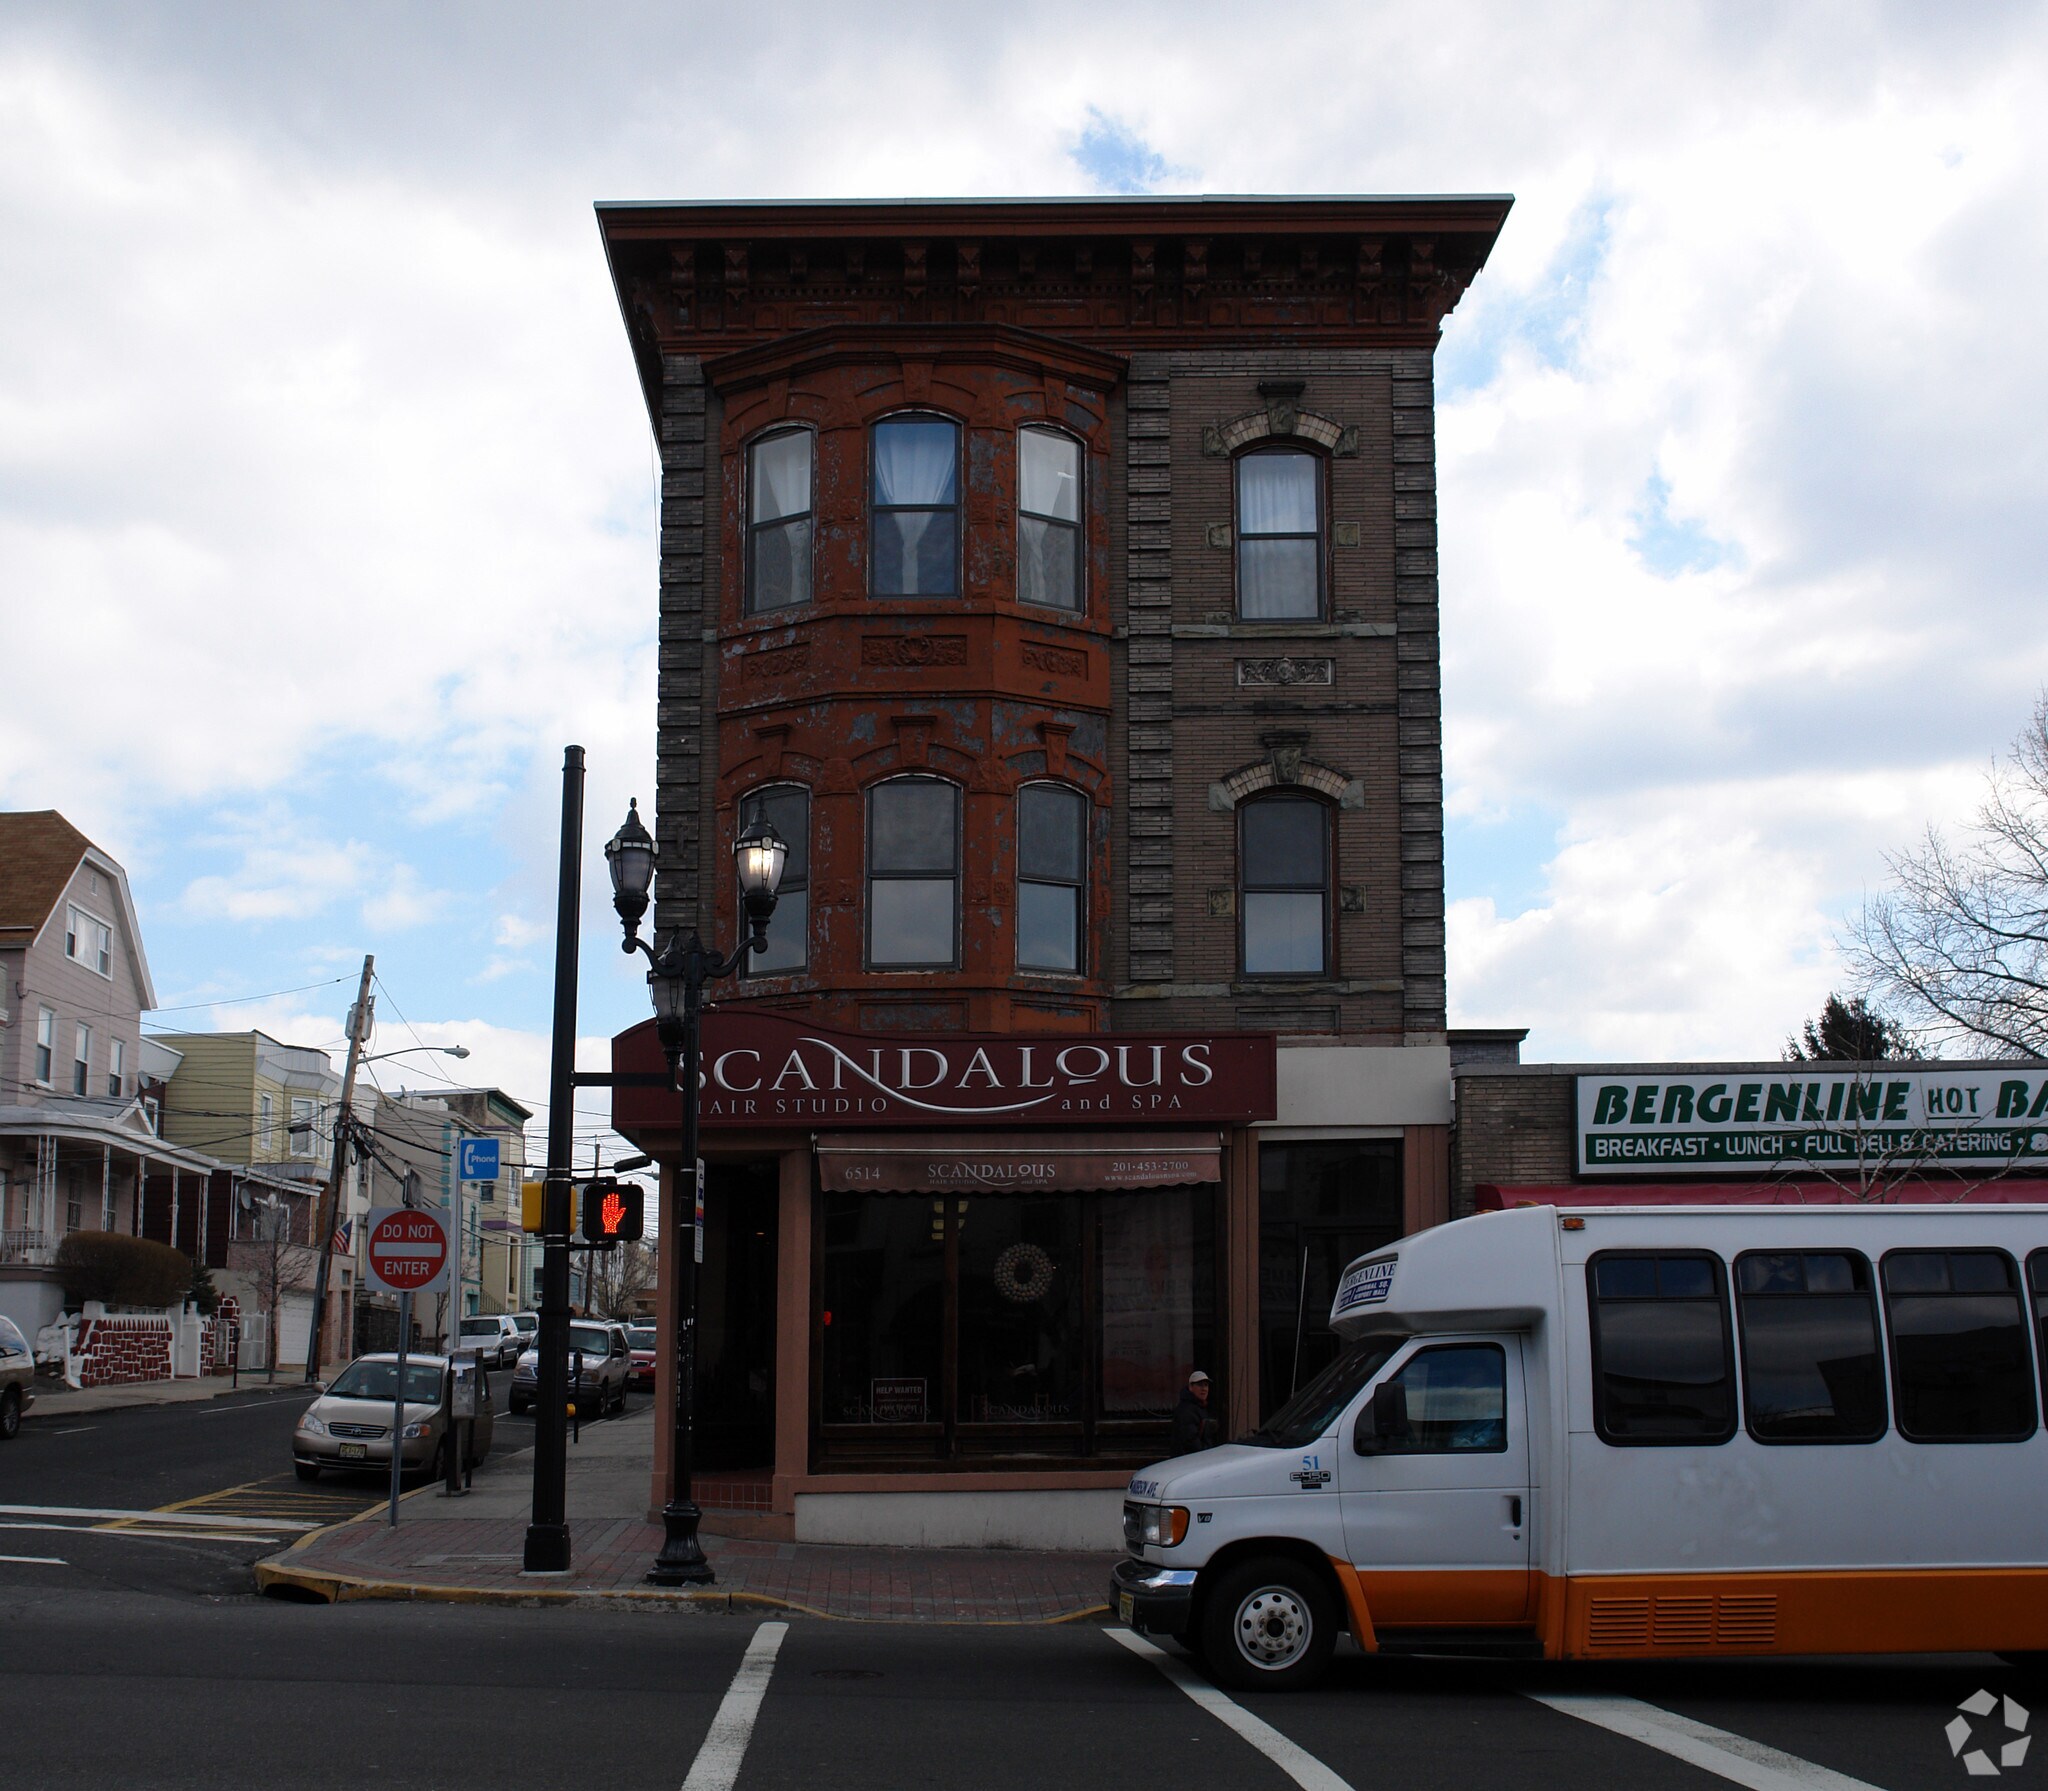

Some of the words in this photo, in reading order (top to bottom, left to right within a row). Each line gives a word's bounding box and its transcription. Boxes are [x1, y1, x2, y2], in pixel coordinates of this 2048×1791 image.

[776, 1097, 888, 1113] STUDIO
[1061, 1095, 1111, 1112] and
[1131, 1094, 1182, 1109] SPA
[1593, 1081, 1910, 1126] BERGENLINE
[1928, 1086, 1981, 1114] HOT
[1595, 1137, 1707, 1158] BREAKFAST
[1725, 1136, 1783, 1156] LUNCH
[1804, 1134, 1847, 1154] FULL
[1899, 1135, 1915, 1151] &
[1922, 1132, 2012, 1152] CATERING
[471, 1155, 496, 1164] Phone
[845, 1166, 880, 1181] 6514
[928, 1162, 1056, 1186] SCANDALOUS
[382, 1223, 401, 1239] DO
[408, 1224, 435, 1239] NOT
[384, 1260, 430, 1276] ENTER
[876, 1386, 894, 1395] HELP
[895, 1386, 922, 1394] WANTED
[1302, 1455, 1319, 1471] 51
[1198, 1514, 1212, 1522] V8
